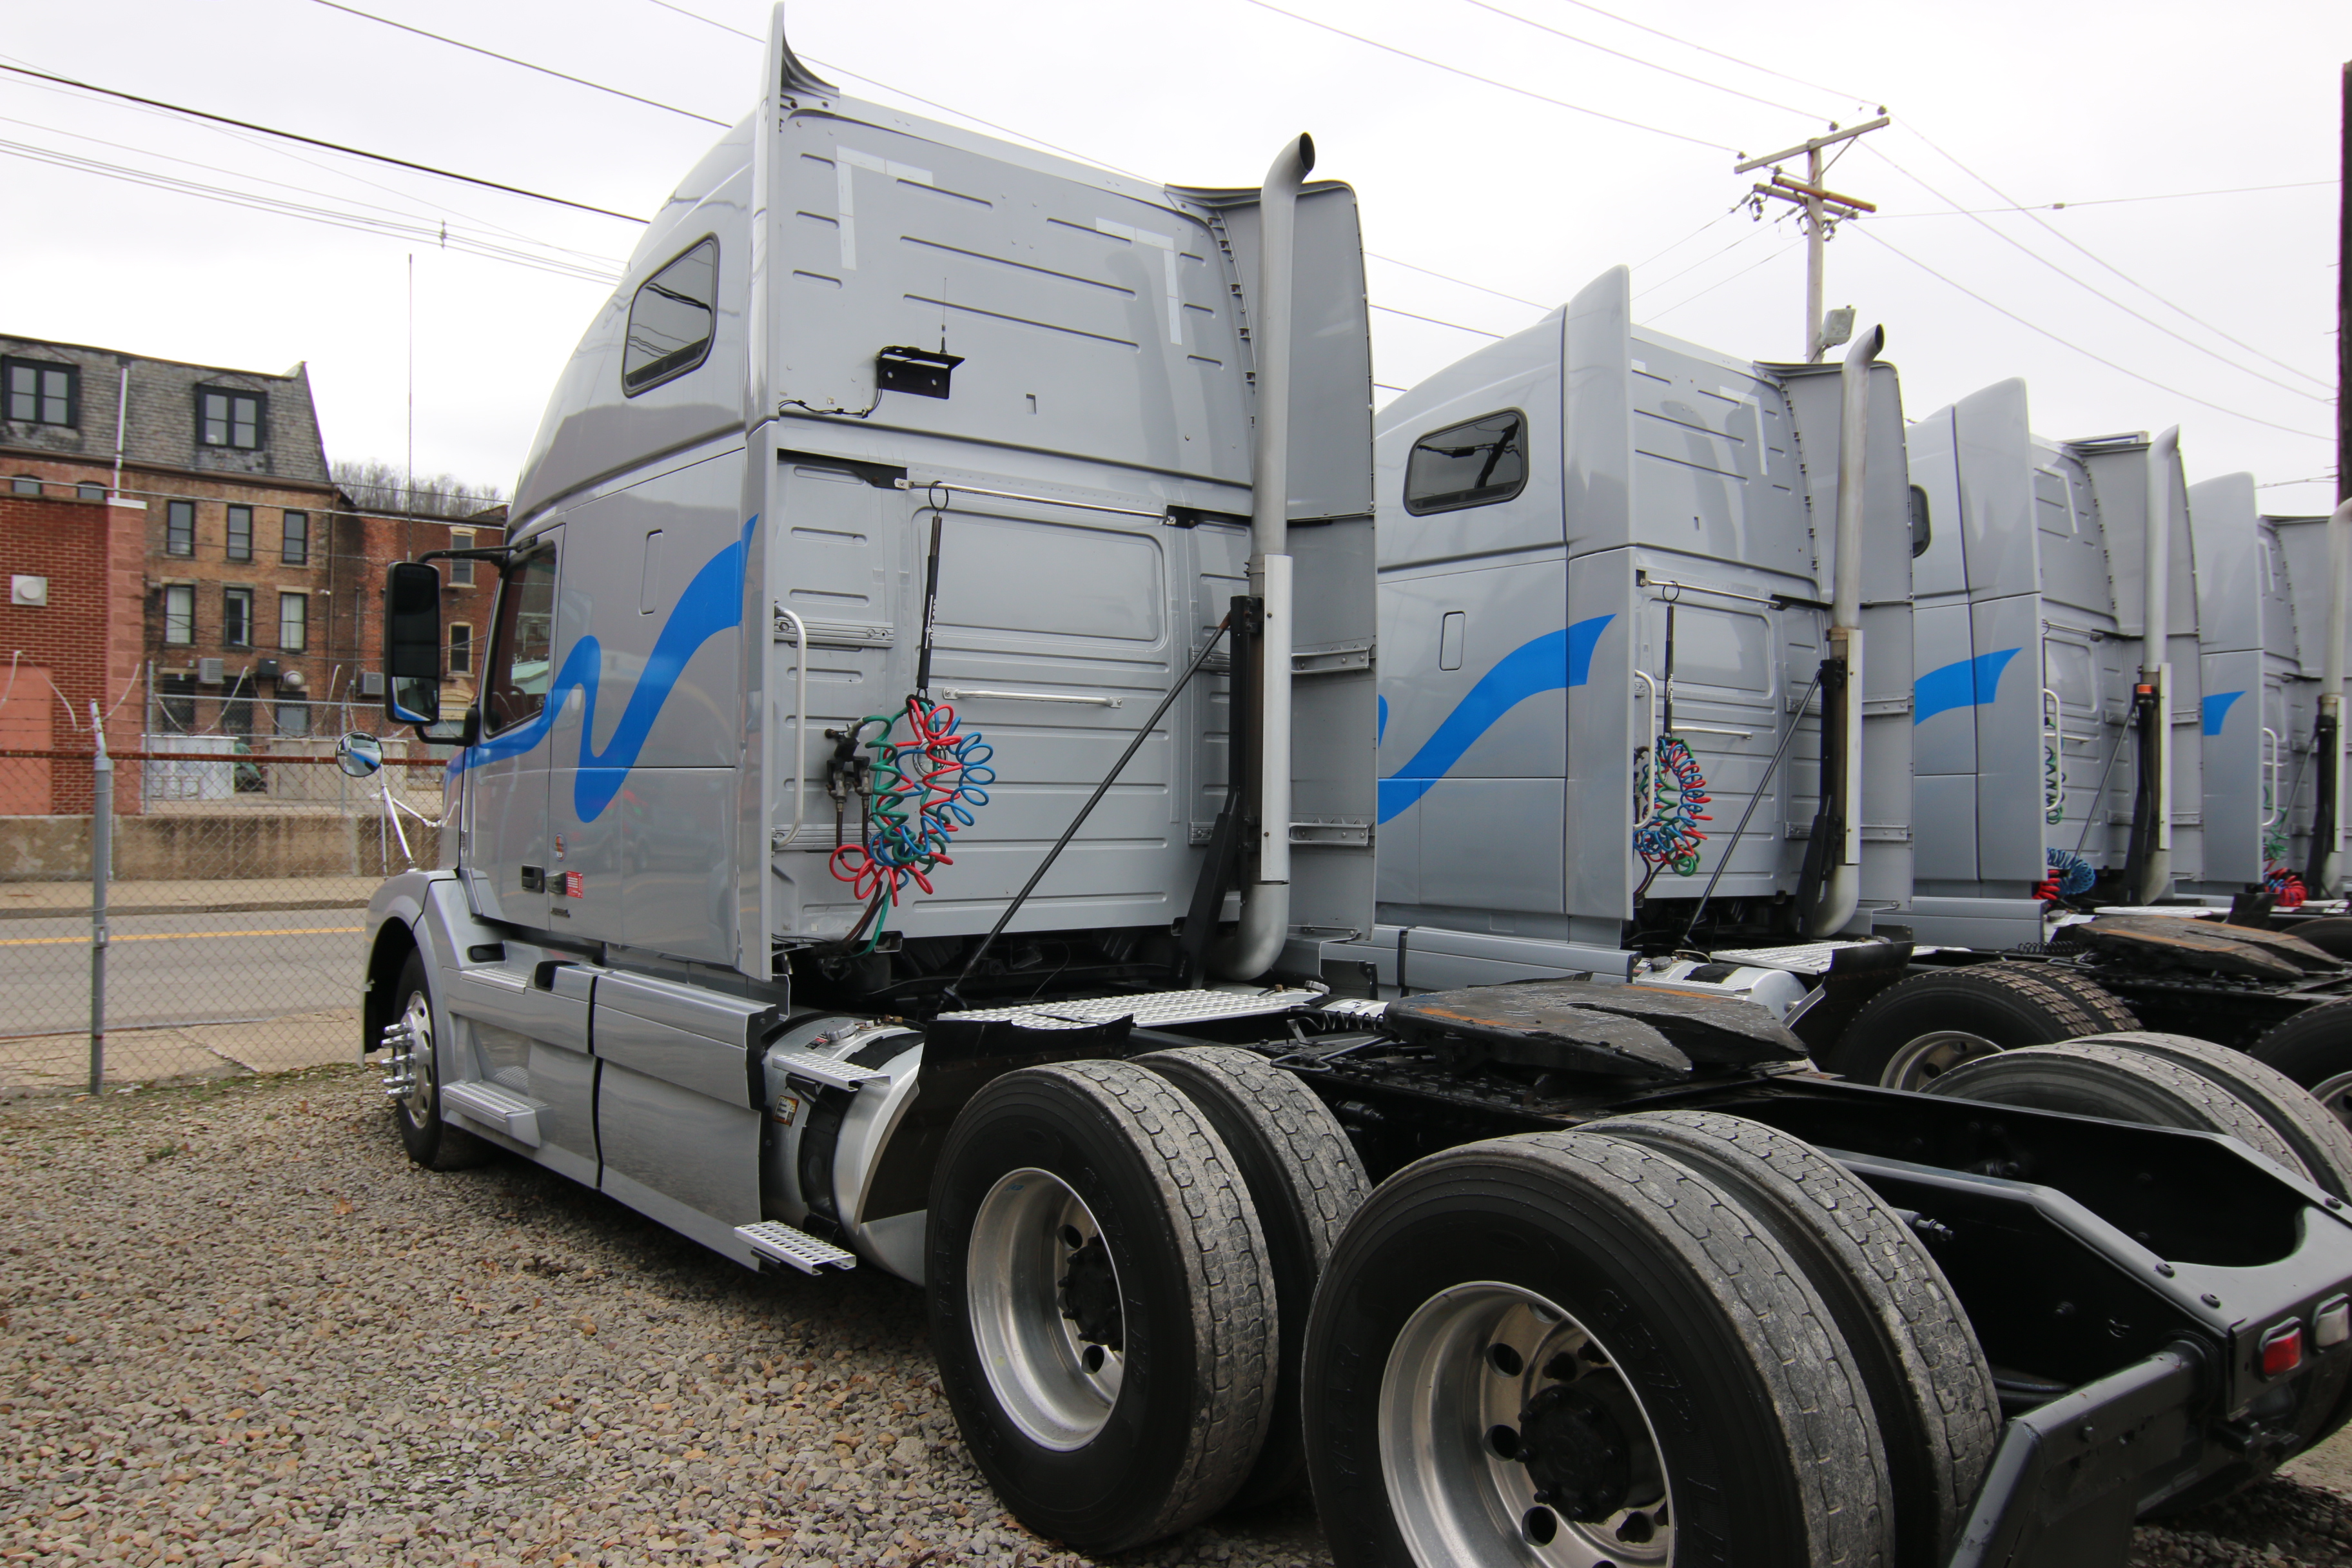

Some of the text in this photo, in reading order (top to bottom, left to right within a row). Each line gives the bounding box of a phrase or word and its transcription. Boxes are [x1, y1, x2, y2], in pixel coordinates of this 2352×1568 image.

[1081, 1167, 1133, 1268] G572
[936, 1218, 1001, 1456] GOODYEAR
[1593, 1288, 1725, 1568] G572 LH
